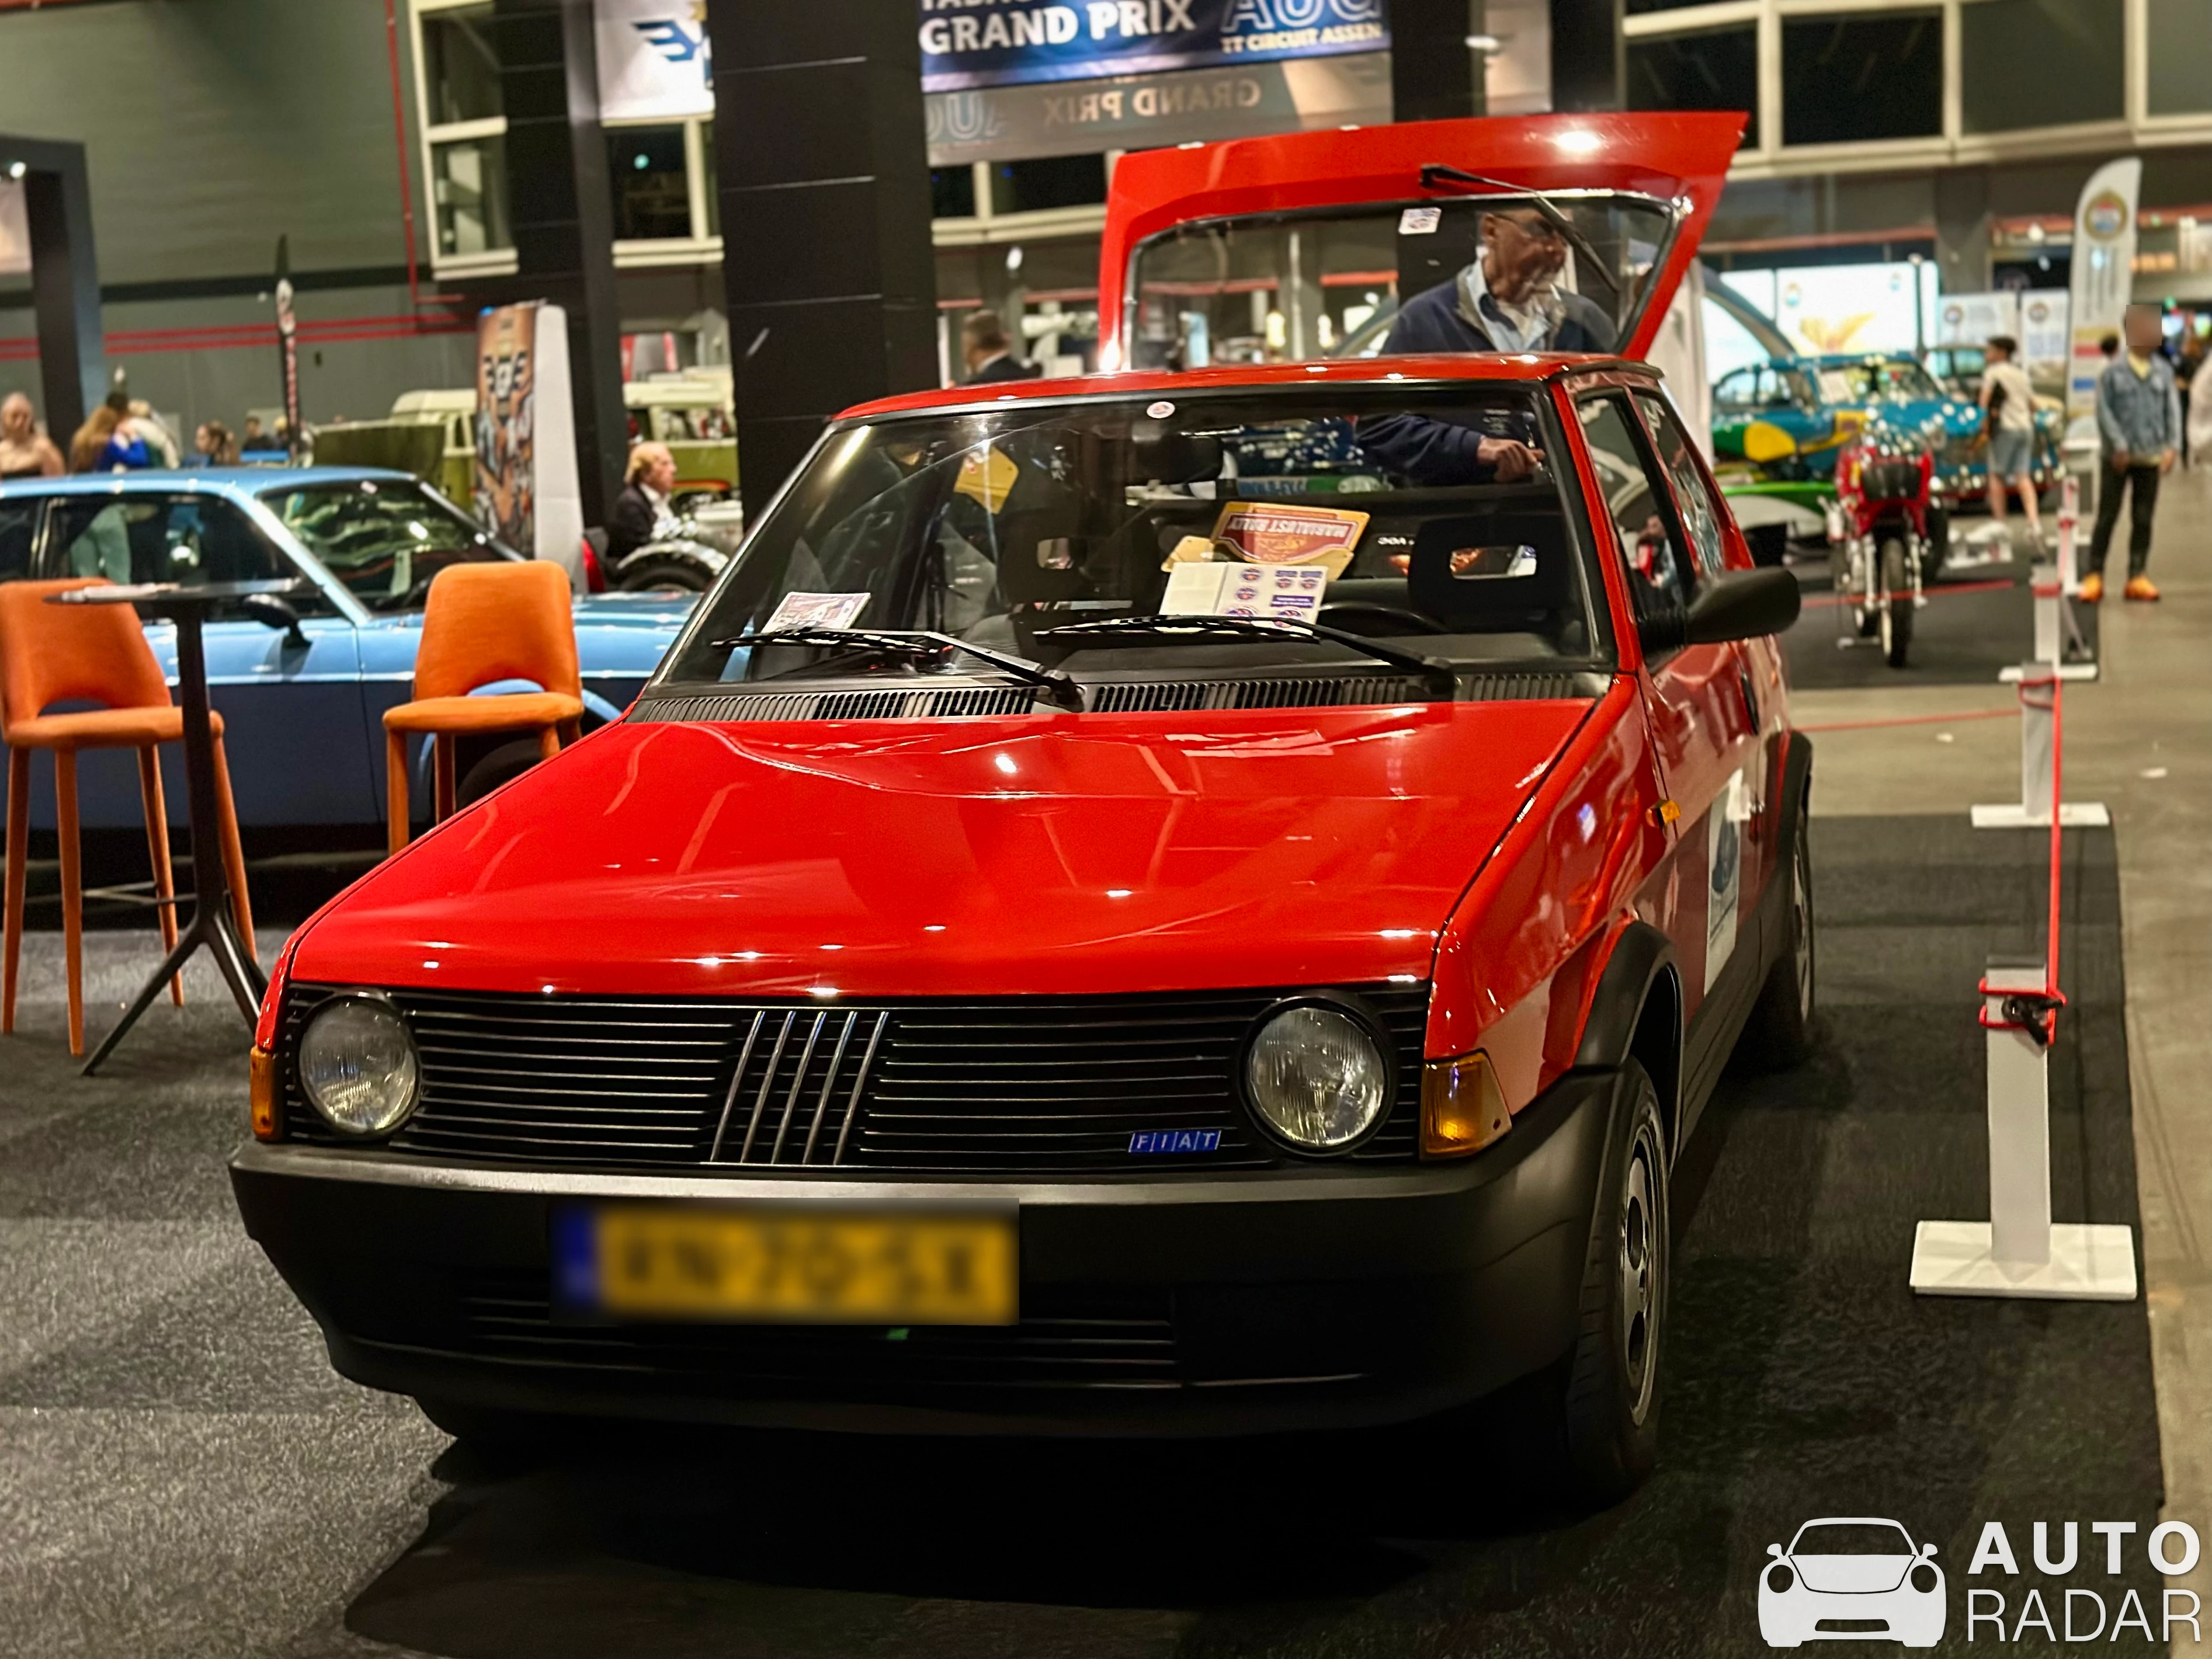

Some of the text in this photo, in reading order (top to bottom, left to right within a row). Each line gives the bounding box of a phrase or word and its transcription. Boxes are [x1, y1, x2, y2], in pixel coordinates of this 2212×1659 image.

[918, 6, 1079, 54] GRAND
[1087, 0, 1195, 40] PRIX
[1220, 22, 1383, 54] TT CIRCUIT ASSEN
[1136, 1132, 1216, 1150] FIAT
